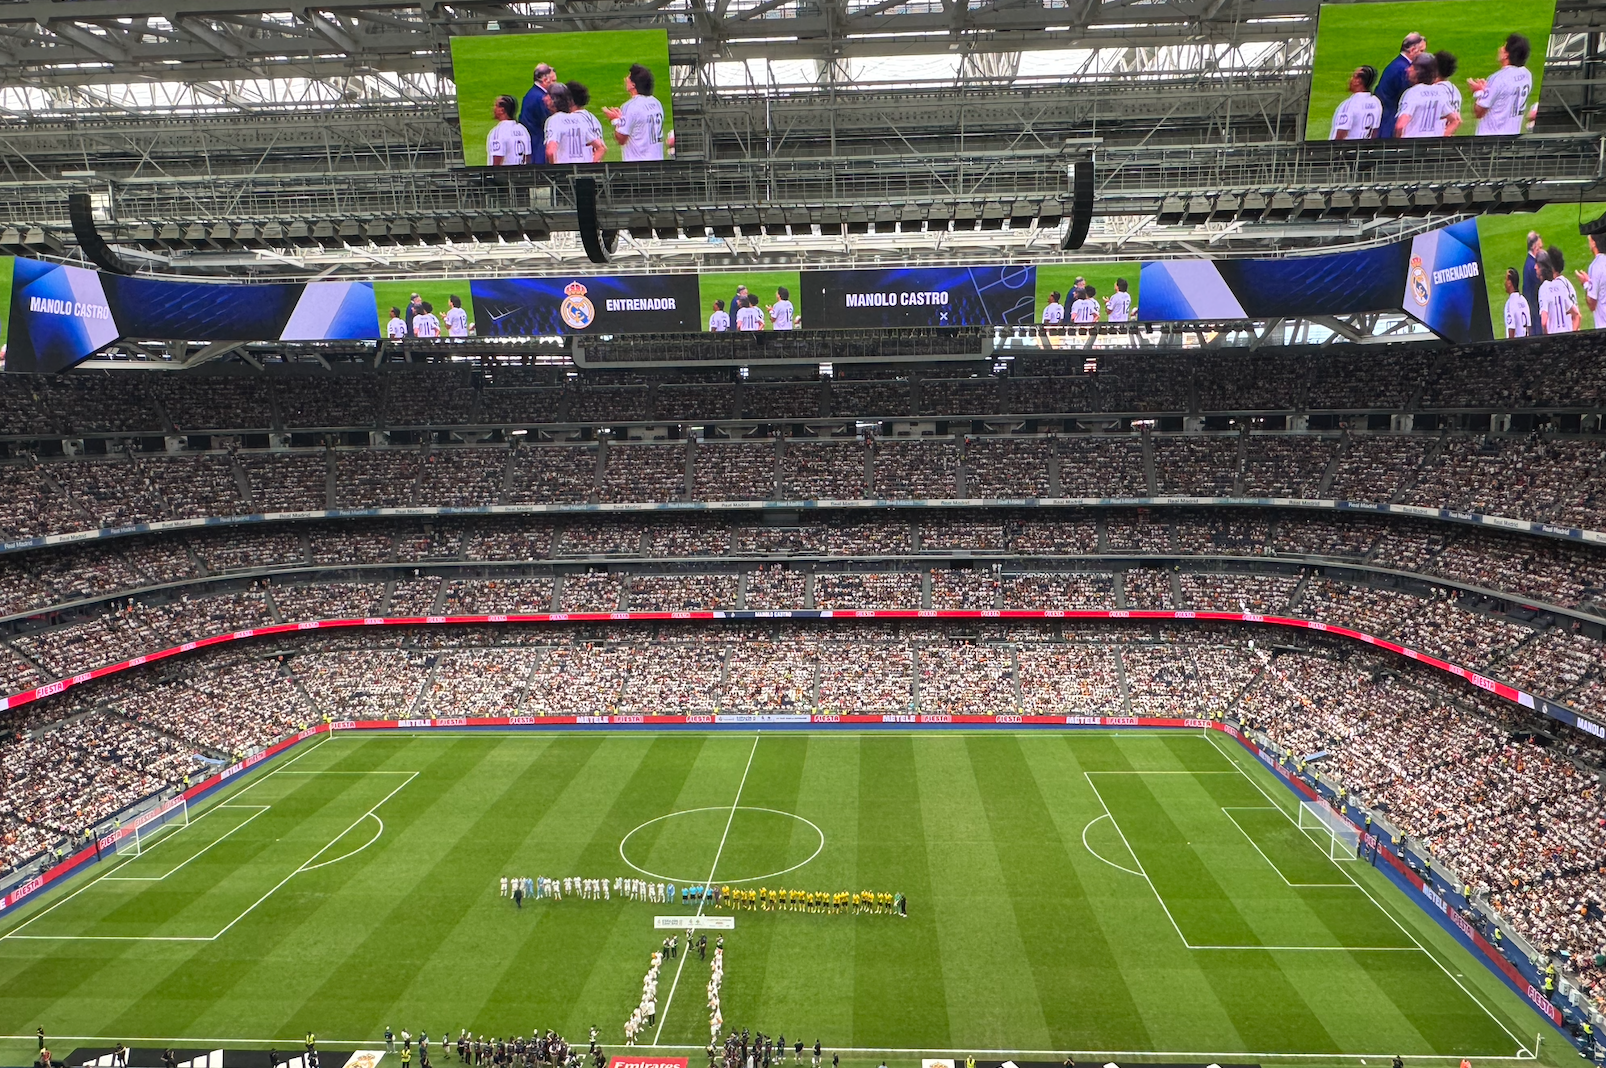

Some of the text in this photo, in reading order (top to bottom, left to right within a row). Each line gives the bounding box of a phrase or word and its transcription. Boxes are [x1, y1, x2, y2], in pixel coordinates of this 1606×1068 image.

[1433, 261, 1479, 285] ENTRENADOR
[30, 296, 109, 320] MANOLO CASTRO
[606, 297, 676, 312] ENTRENADOR
[846, 291, 949, 308] MANOLO CASTRO
[73, 672, 91, 684] FIESTA
[1472, 674, 1495, 692] FIESTA
[36, 681, 64, 699] FIESTA
[330, 721, 356, 730] FIESTA
[437, 718, 466, 726] FIESTA
[814, 715, 840, 723] FIESTA
[996, 715, 1022, 723] FIESTA
[1184, 719, 1212, 727] FIESTA
[1577, 717, 1605, 739] MANOLO
[100, 830, 122, 850] FIESTA
[15, 879, 40, 900] FIESTA
[1452, 913, 1473, 936] FIESTA
[1528, 984, 1554, 1020] FIESTA
